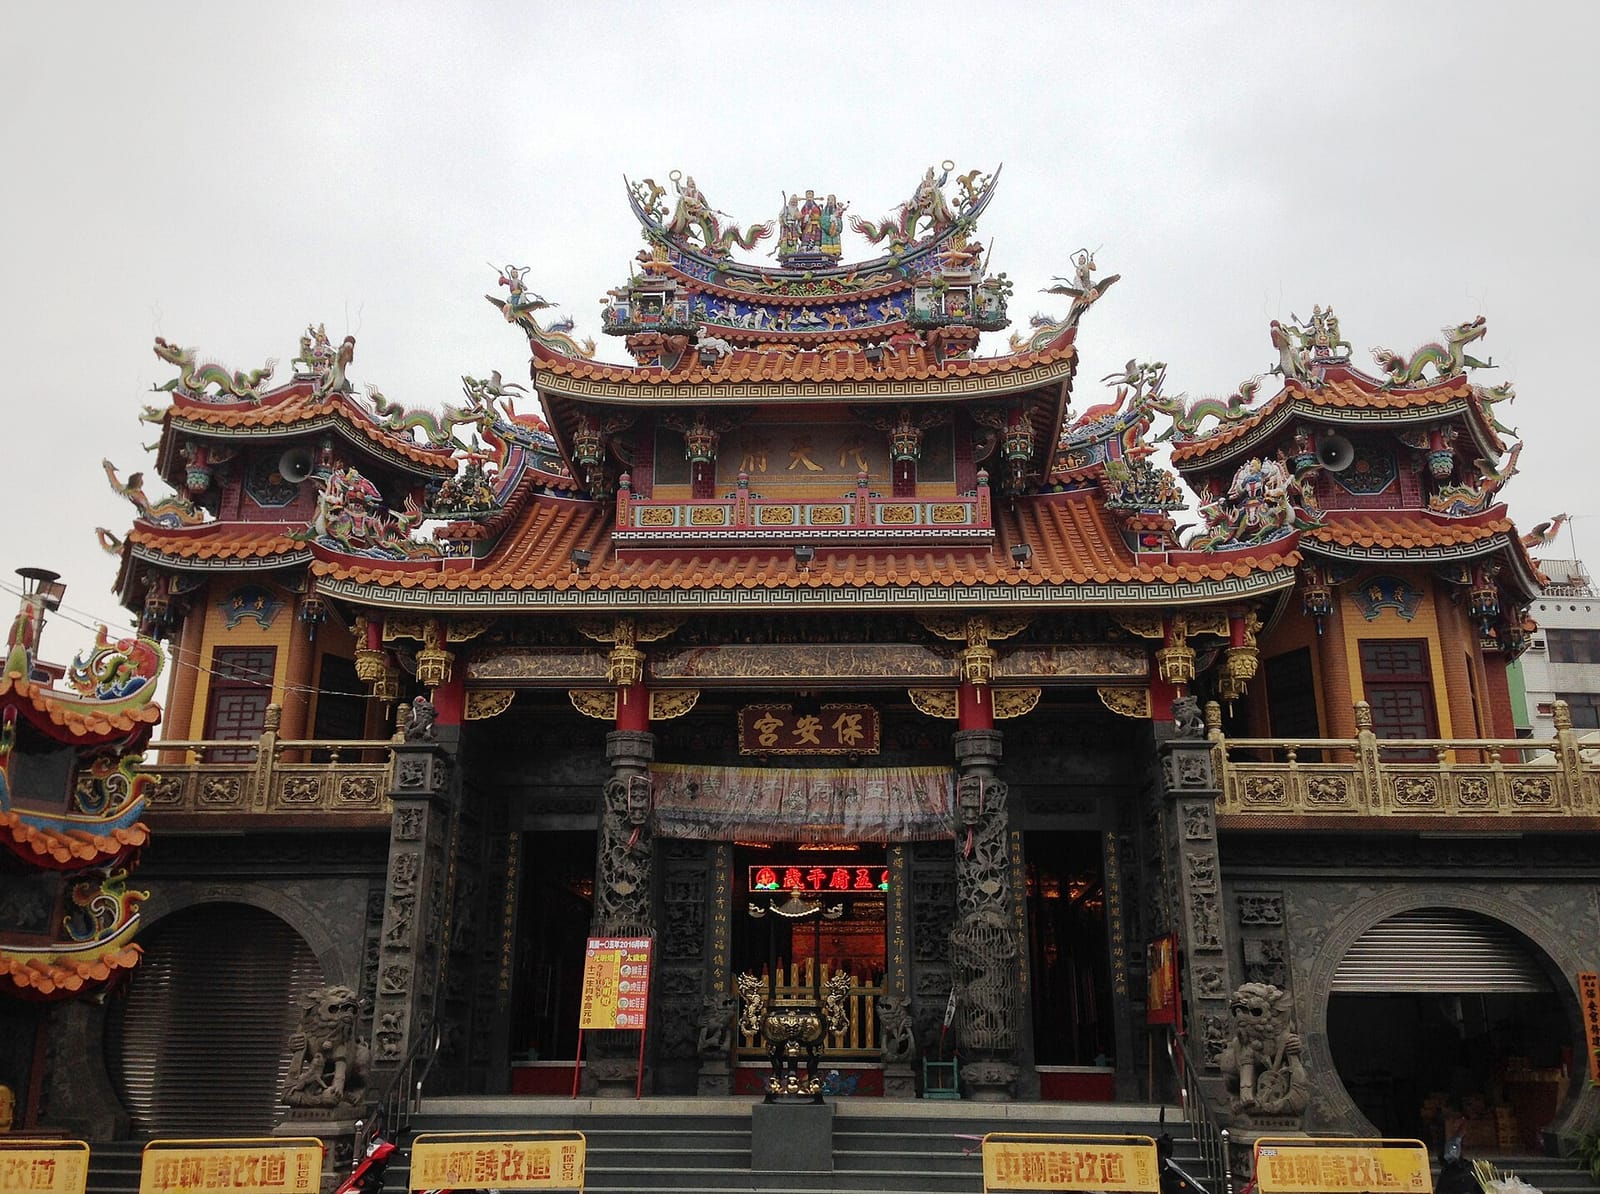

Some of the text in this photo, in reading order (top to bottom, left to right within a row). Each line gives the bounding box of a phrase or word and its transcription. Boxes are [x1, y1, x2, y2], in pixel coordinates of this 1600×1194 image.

[753, 712, 865, 747] 保安宮
[783, 867, 874, 891] 五府千歲
[153, 1154, 286, 1191] 車輛請改道
[424, 1148, 551, 1183] 車輛請改道
[996, 1150, 1126, 1185] 車輛請改道
